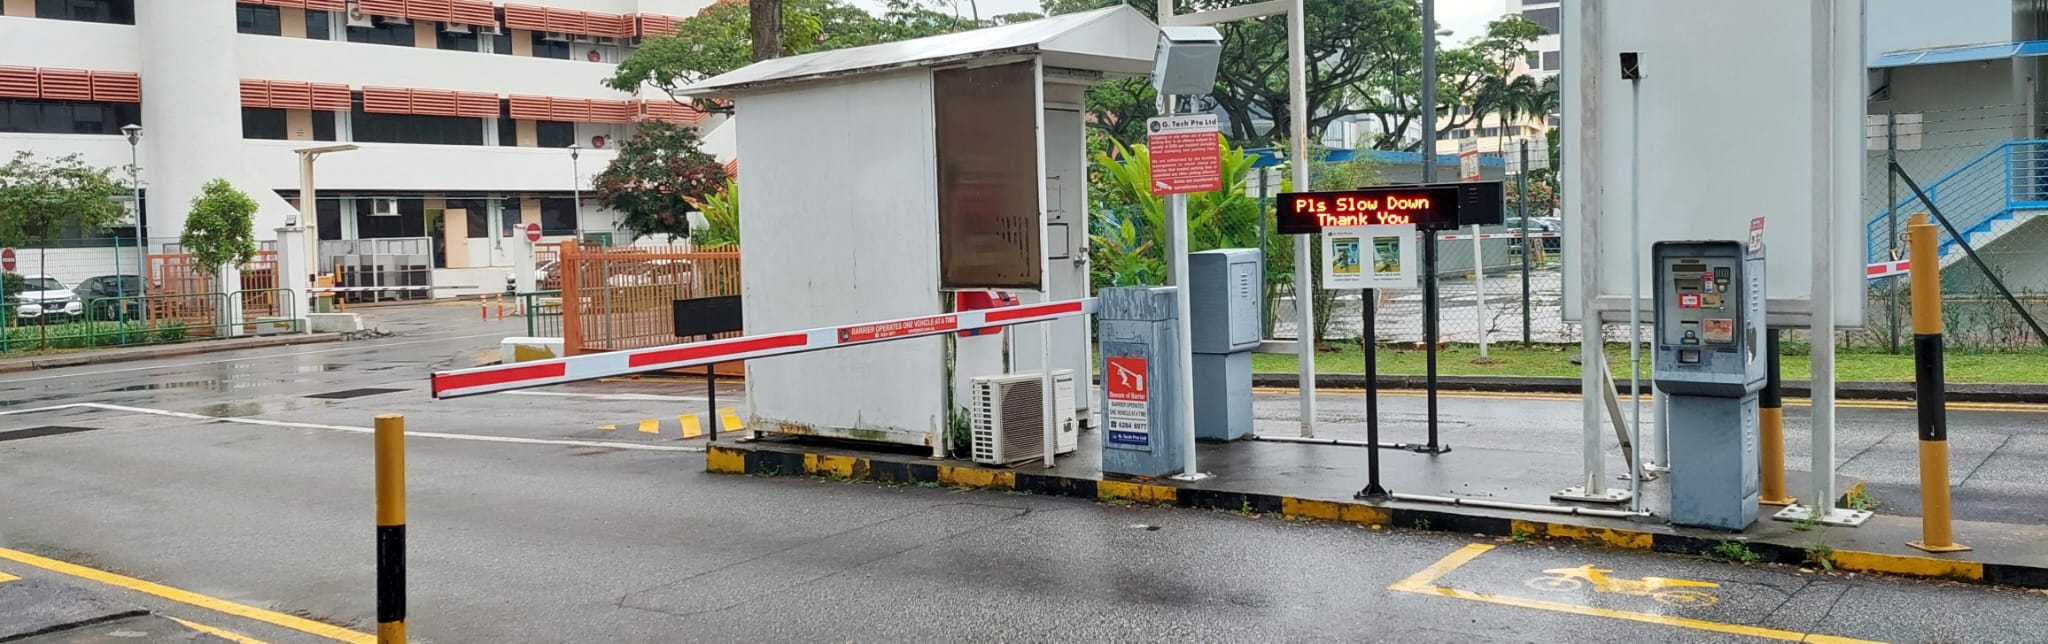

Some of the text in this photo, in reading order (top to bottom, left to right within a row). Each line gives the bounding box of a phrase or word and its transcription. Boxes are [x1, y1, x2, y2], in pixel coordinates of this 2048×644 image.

[1296, 196, 1430, 212] Pls Slow Down
[1317, 211, 1409, 226] Thank You
[914, 318, 934, 327] VEHICLE
